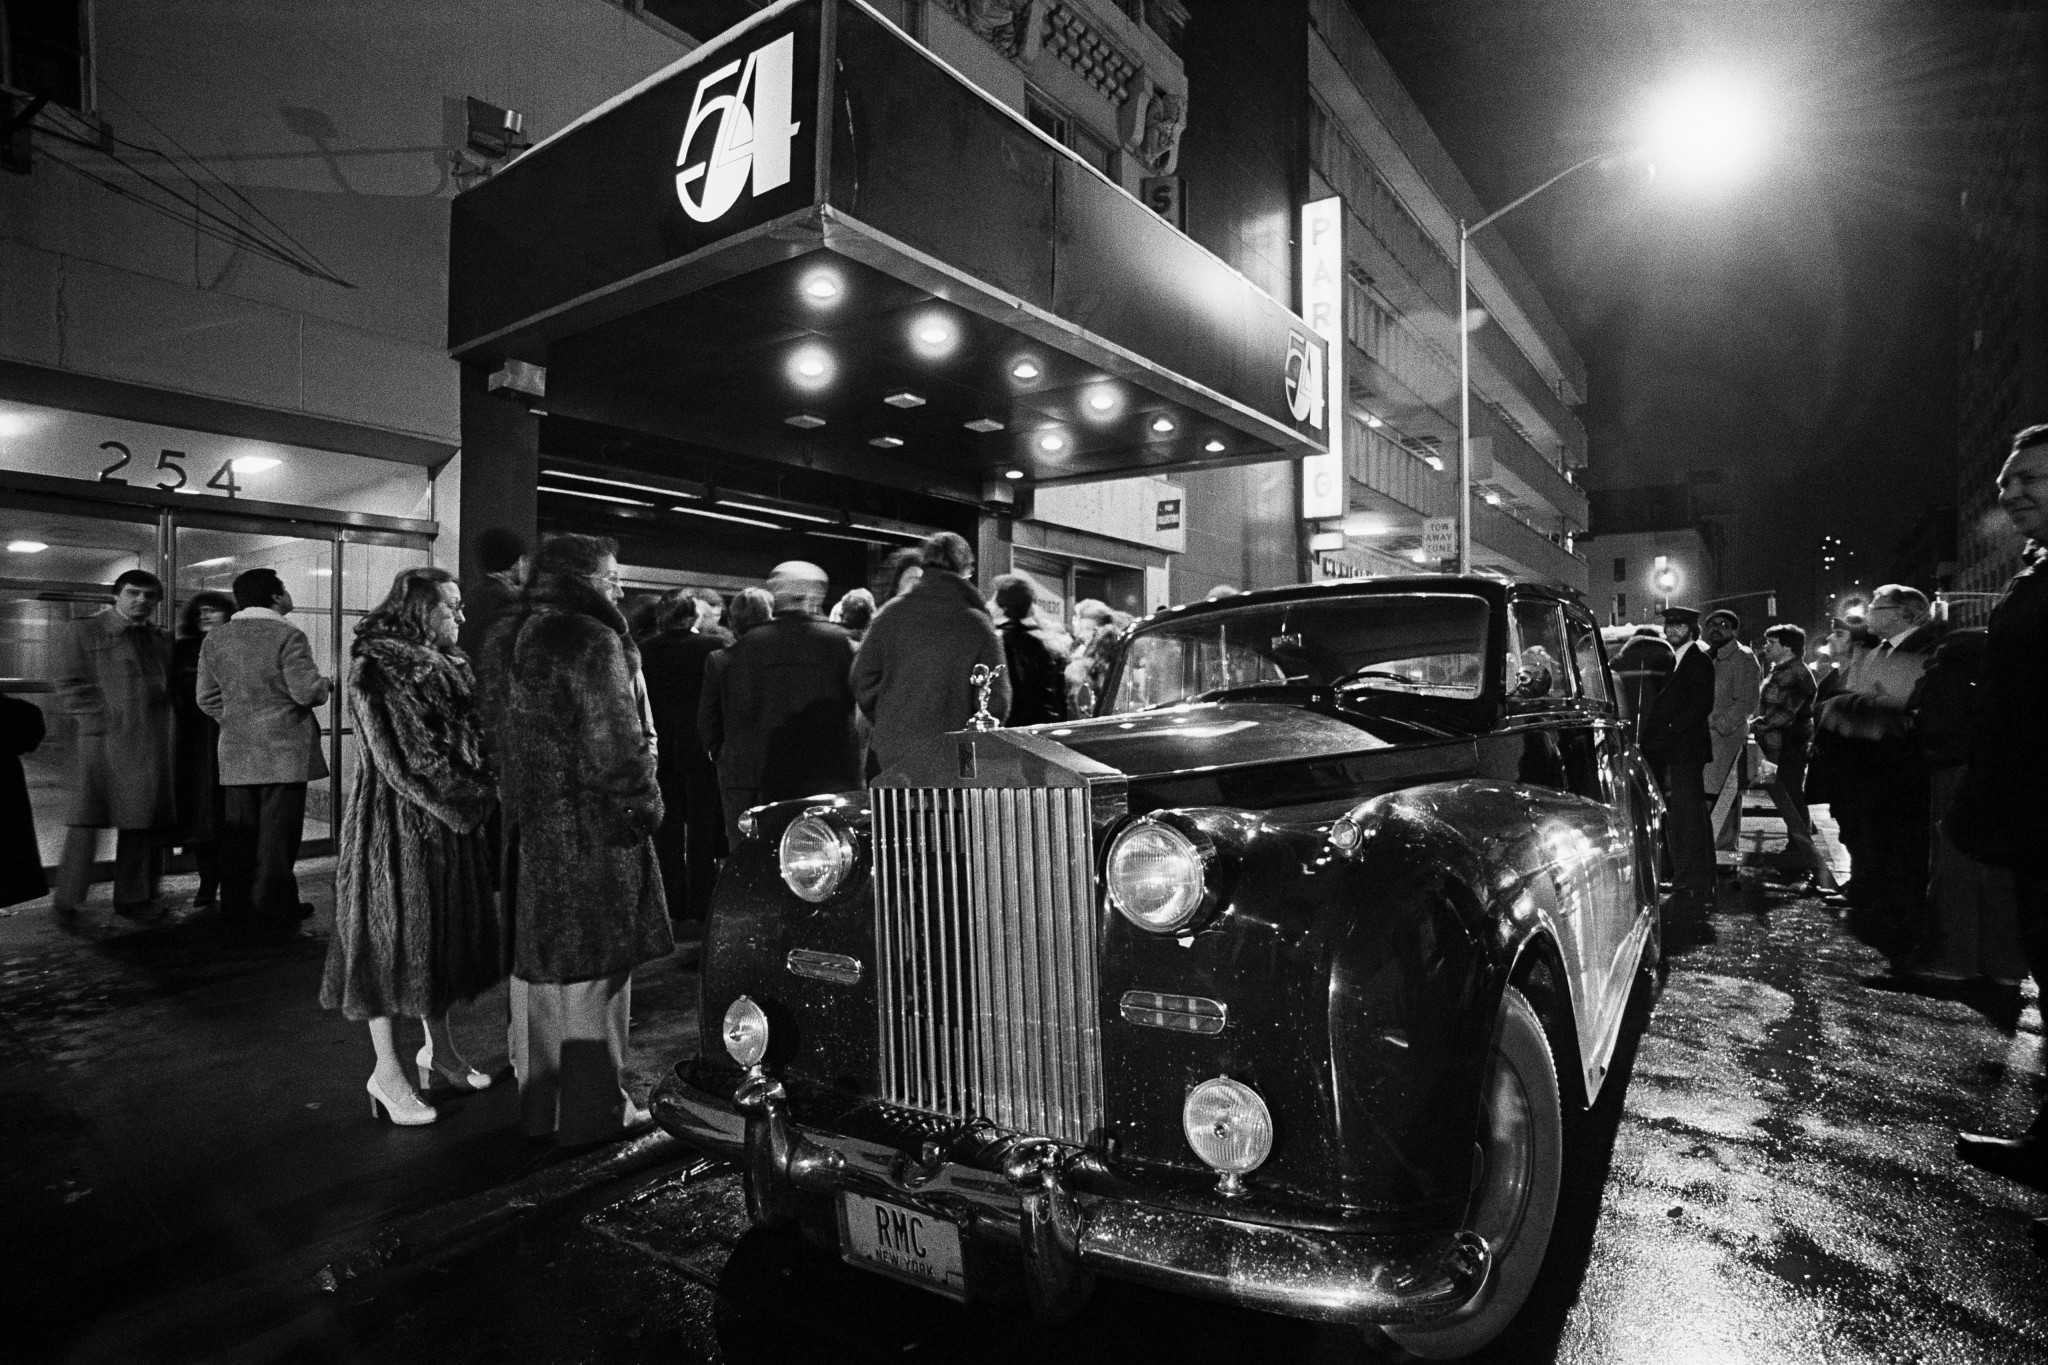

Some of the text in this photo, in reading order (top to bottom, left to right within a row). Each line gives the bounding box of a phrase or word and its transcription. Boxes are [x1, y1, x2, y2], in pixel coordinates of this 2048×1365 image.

[676, 32, 800, 222] 54
[1285, 329, 1325, 429] 54
[1312, 217, 1332, 498] PARG
[100, 441, 241, 498] 254
[1425, 533, 1452, 542] AWAY
[1426, 543, 1452, 553] ZONE
[1430, 523, 1449, 532] TOW
[876, 1204, 926, 1258] RMC
[876, 1247, 935, 1279] NEW YORK
